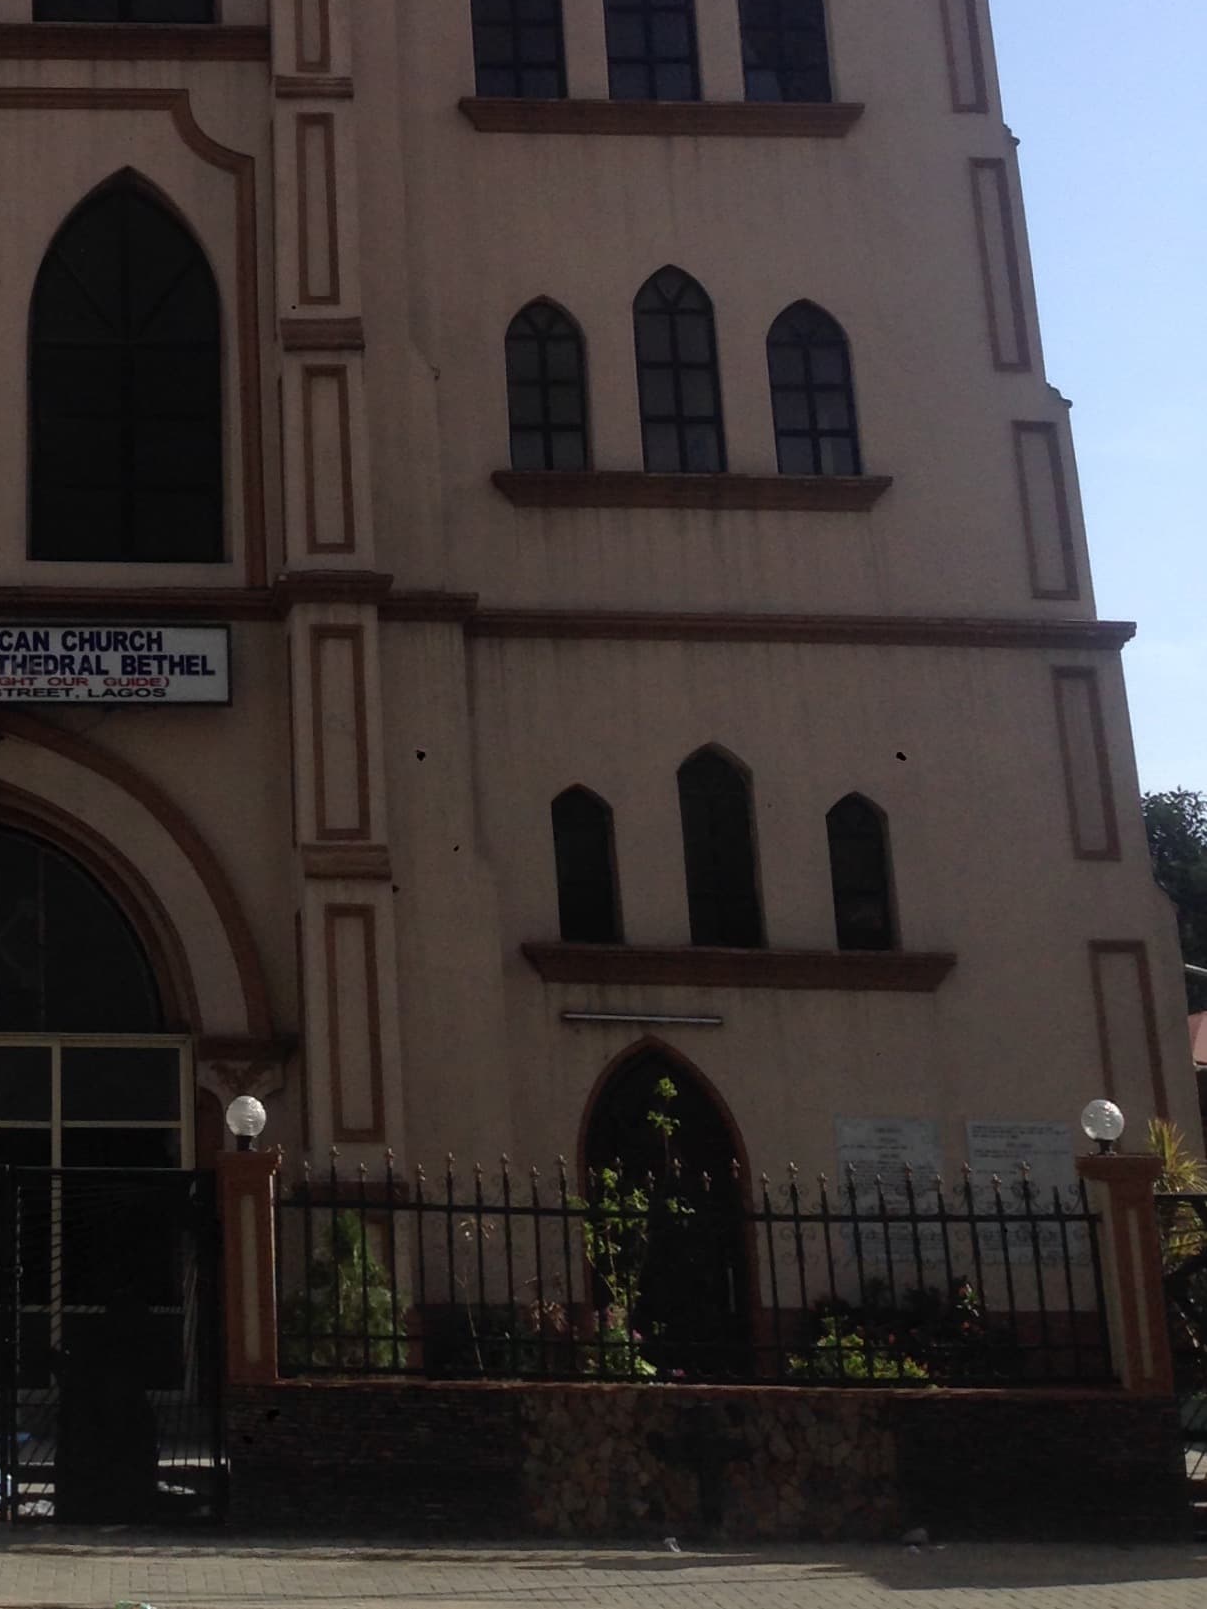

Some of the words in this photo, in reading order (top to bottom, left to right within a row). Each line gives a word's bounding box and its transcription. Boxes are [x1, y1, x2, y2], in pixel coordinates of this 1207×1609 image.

[61, 630, 163, 652] CHURCH
[121, 654, 215, 676] BETHEL
[46, 676, 89, 687] OUR
[103, 676, 170, 688] GUIDE)
[88, 687, 166, 698] LAGOS
